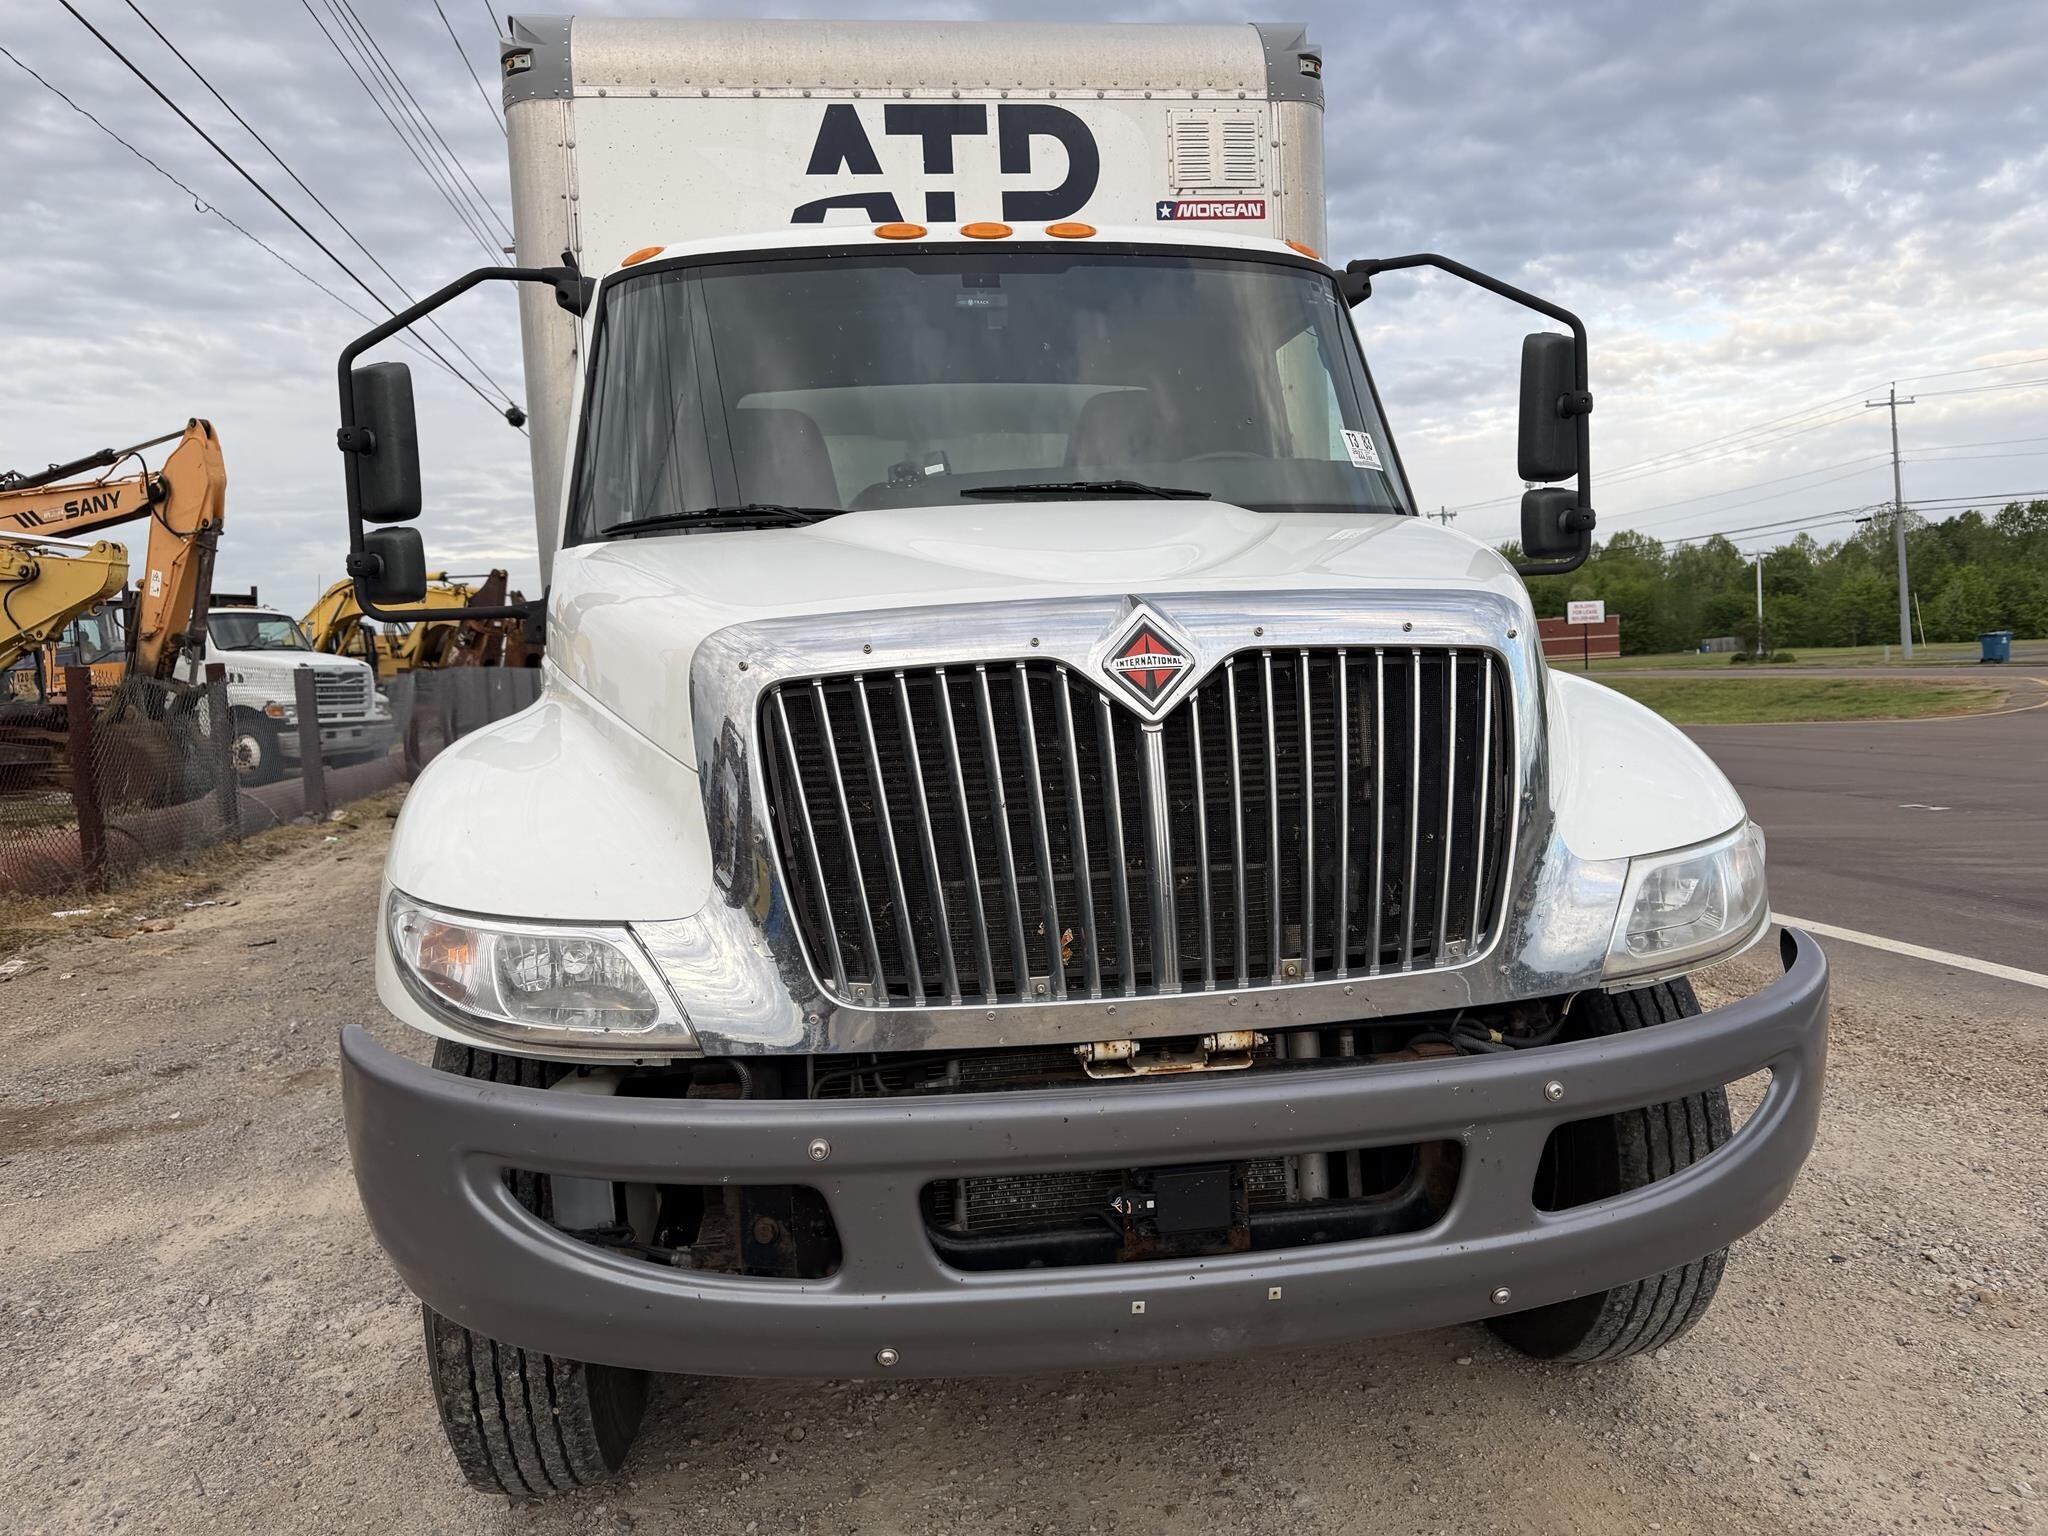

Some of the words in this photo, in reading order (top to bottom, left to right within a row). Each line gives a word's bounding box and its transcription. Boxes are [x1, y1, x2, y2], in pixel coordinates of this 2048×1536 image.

[790, 104, 1100, 223] ATD
[1176, 203, 1261, 217] MORGAN
[64, 490, 121, 520] SANY
[1116, 655, 1182, 668] INTERNATIONAL
